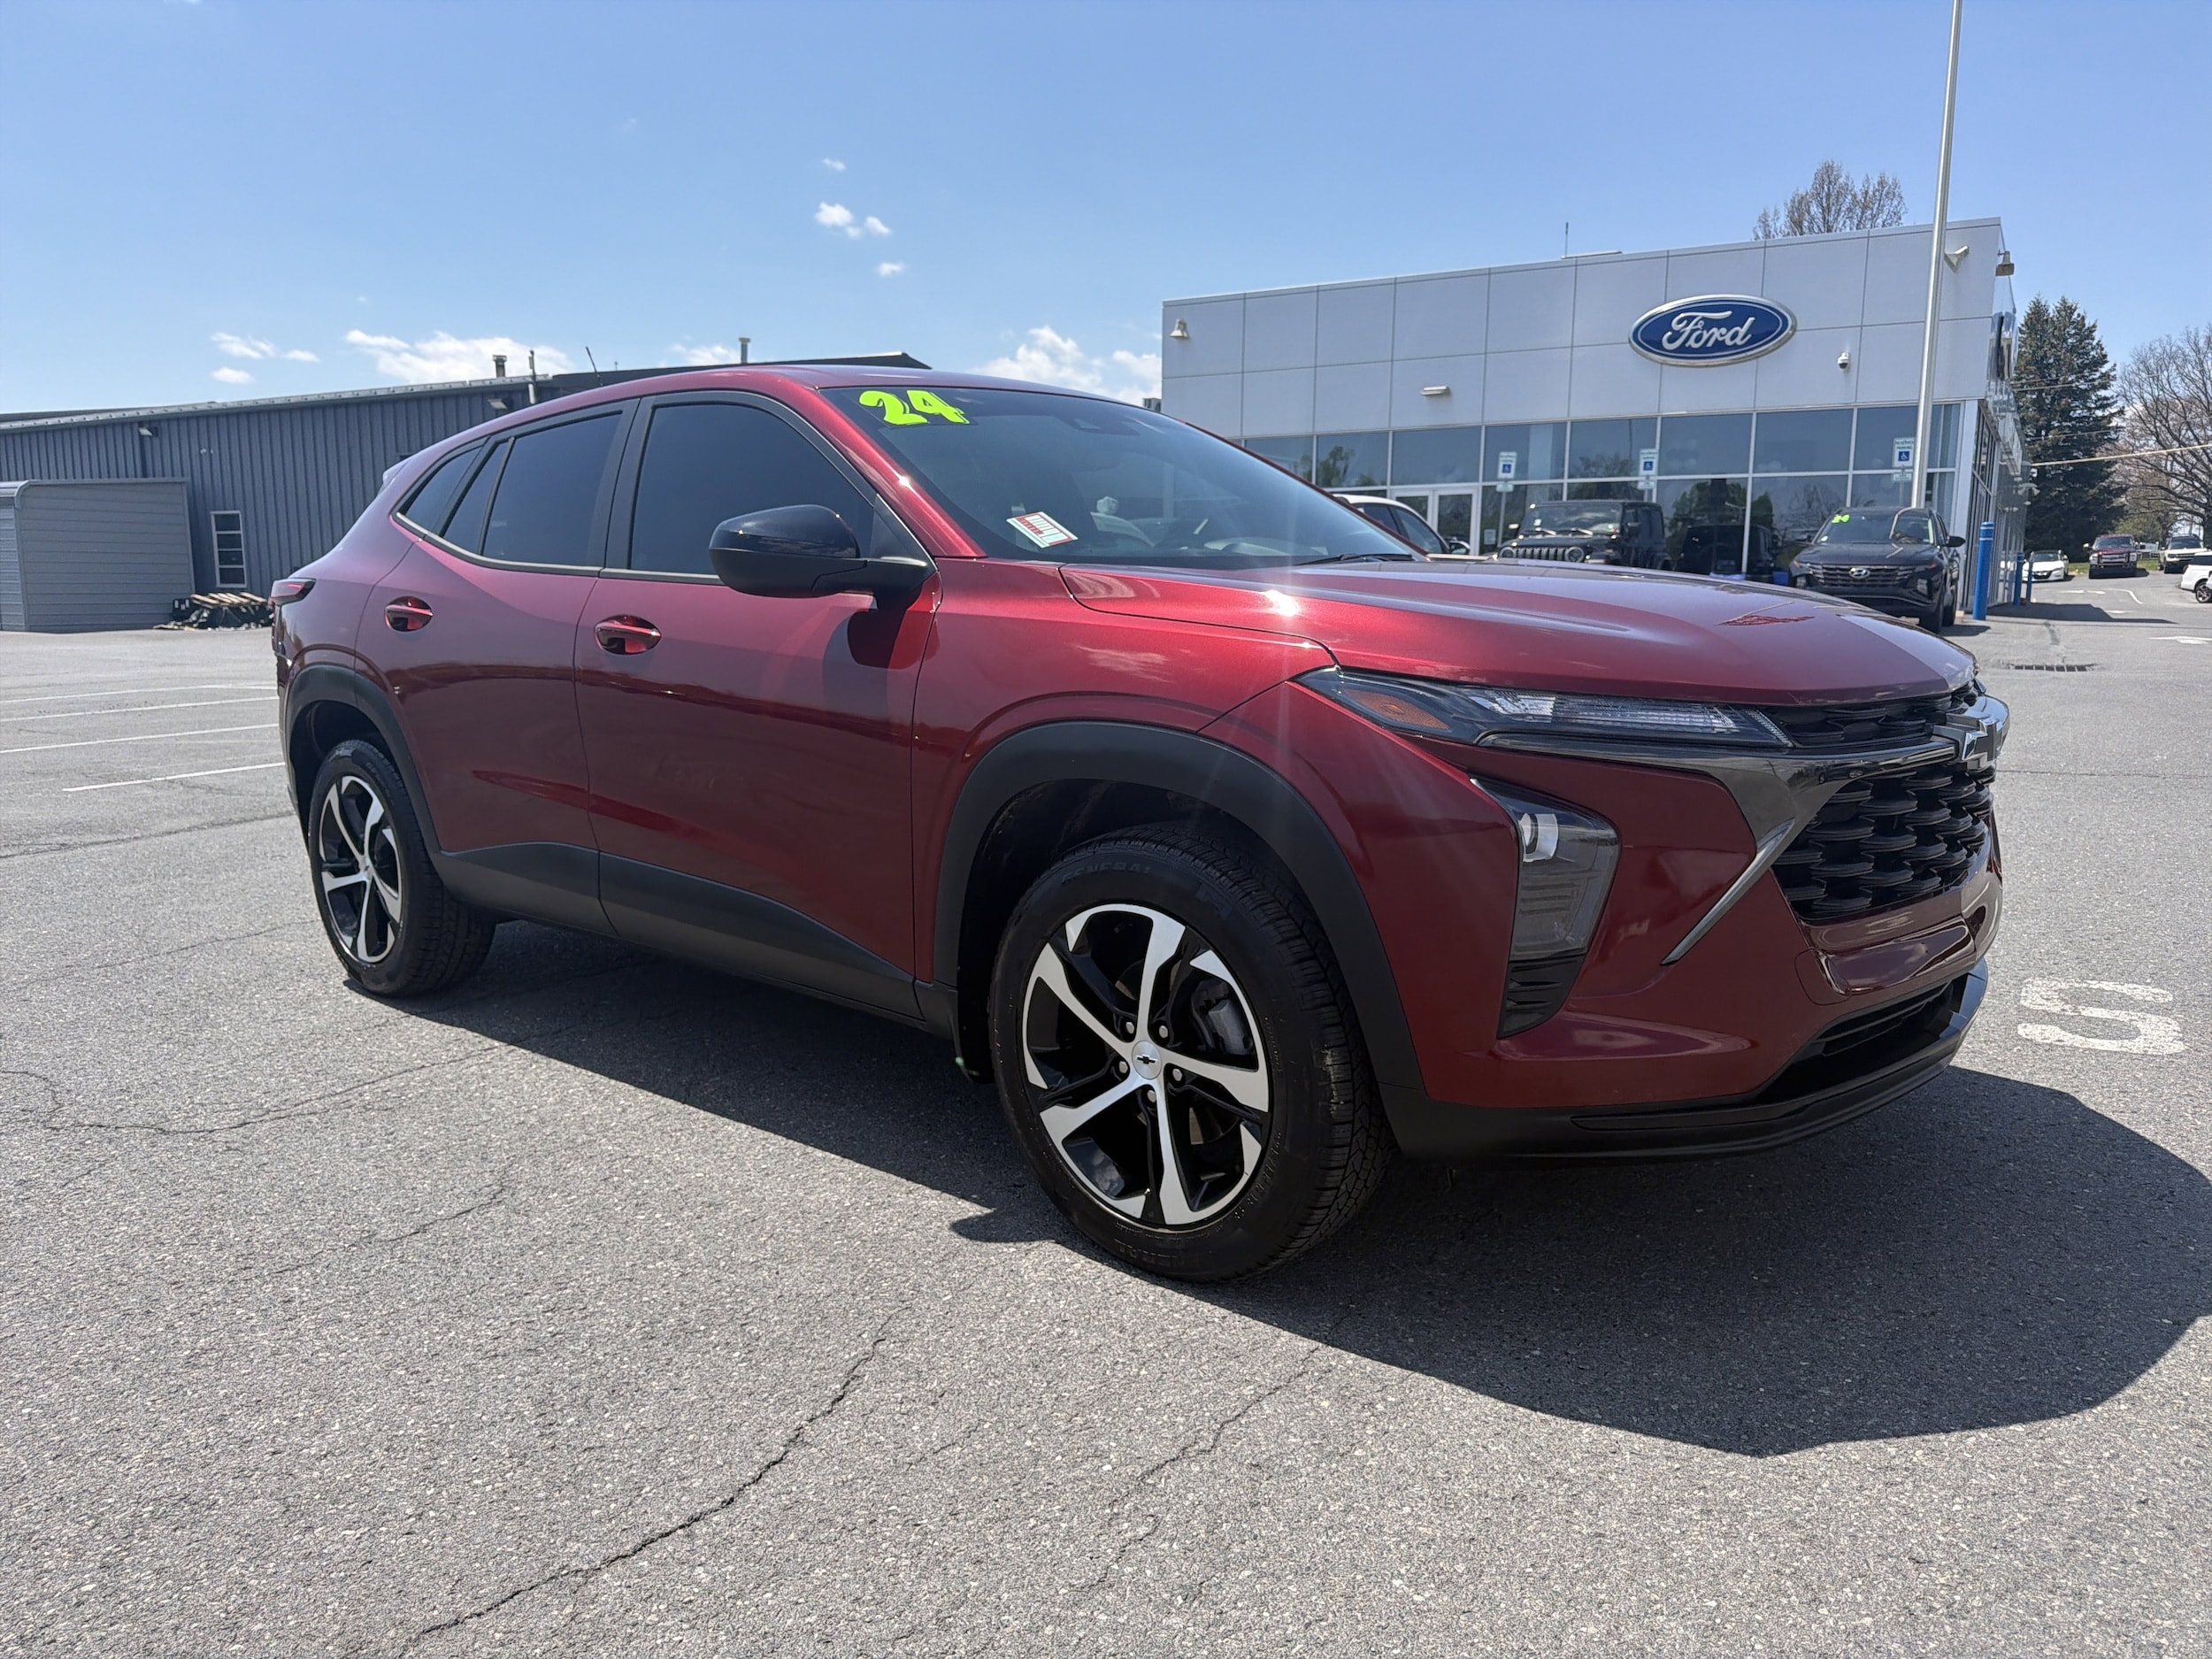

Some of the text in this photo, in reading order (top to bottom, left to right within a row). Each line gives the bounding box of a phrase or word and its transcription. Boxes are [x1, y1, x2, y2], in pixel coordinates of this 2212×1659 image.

[1662, 311, 1755, 350] Ford
[859, 389, 971, 426] 24
[2017, 977, 2187, 1055] S
